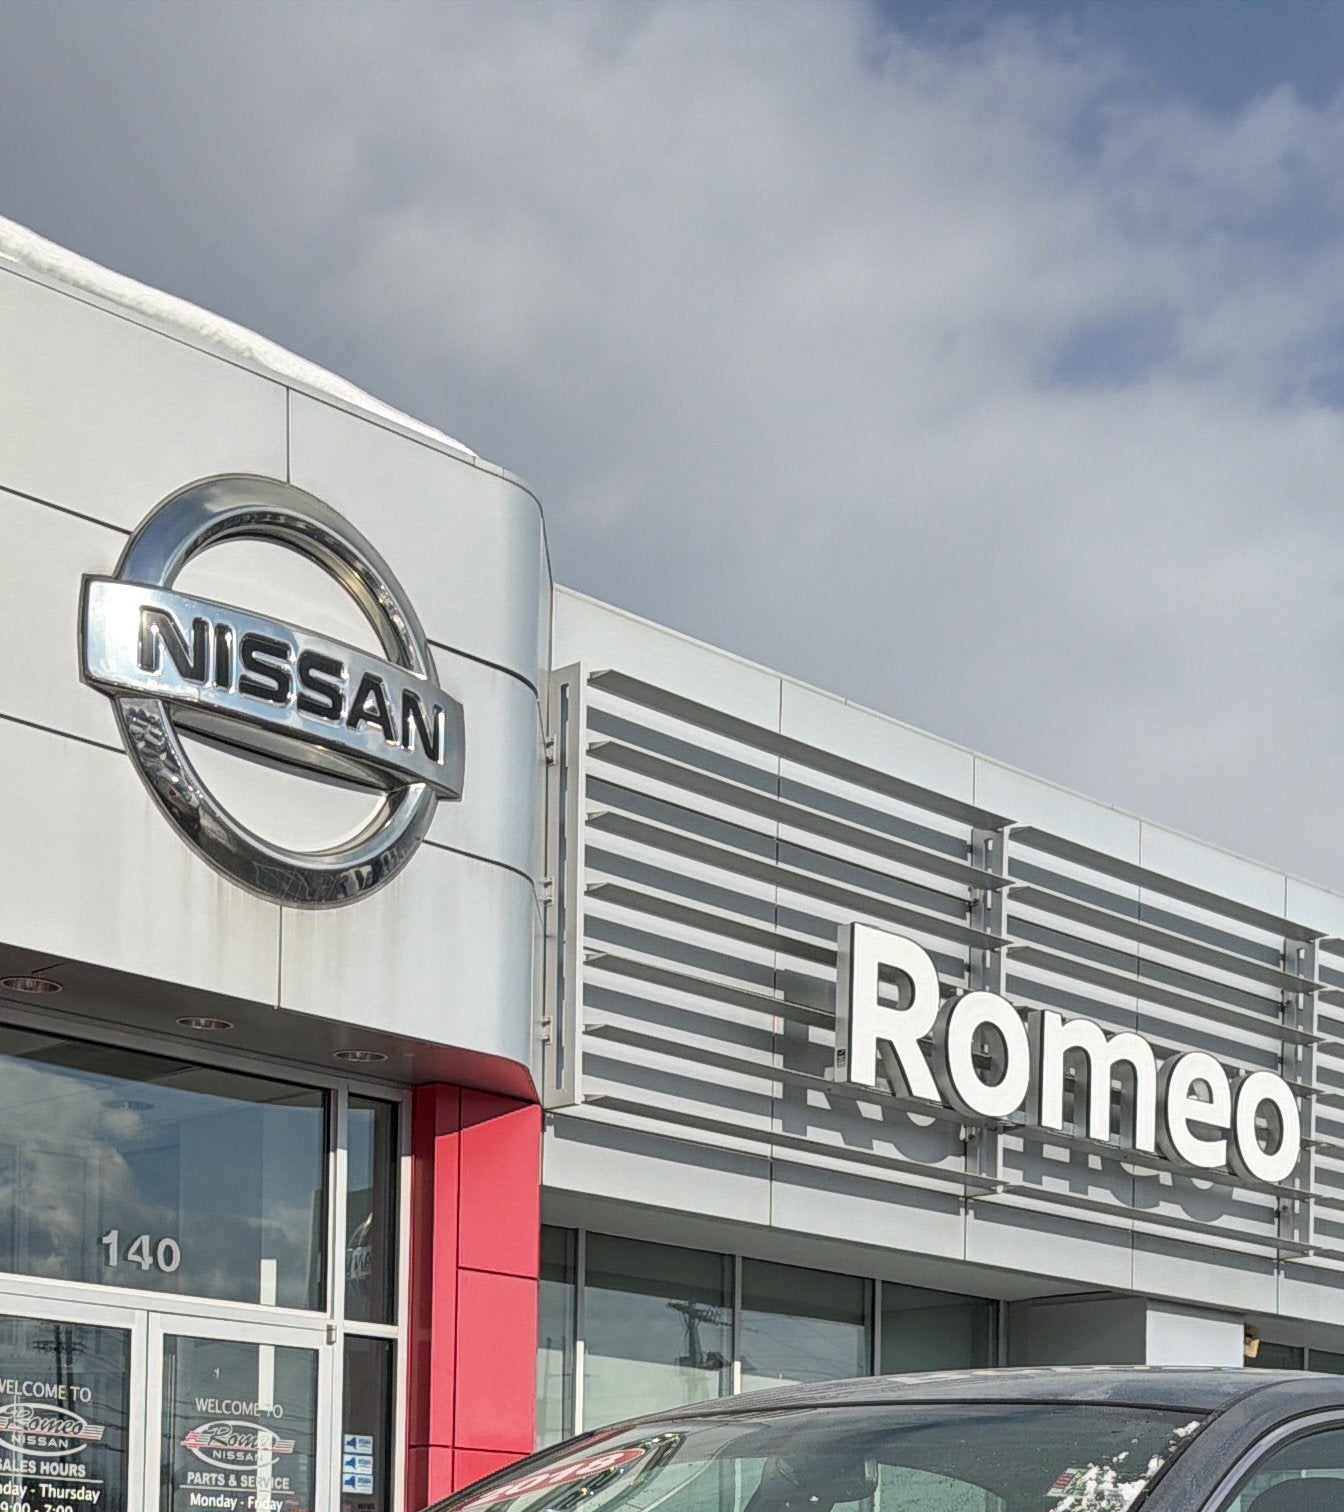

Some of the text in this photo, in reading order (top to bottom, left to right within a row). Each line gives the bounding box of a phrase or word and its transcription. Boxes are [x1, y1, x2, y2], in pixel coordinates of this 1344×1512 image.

[137, 605, 446, 765] NISSAN
[837, 921, 1301, 1183] Romeo
[101, 1229, 181, 1273] 140
[70, 1386, 92, 1403] TO
[195, 1397, 261, 1417] WELCOME
[0, 1406, 84, 1435] Romeo
[11, 1434, 69, 1449] NISSAN
[212, 1450, 263, 1462] NISSAN
[40, 1461, 86, 1477] HOURS
[187, 1472, 290, 1490] PARTS & SERVICE
[39, 1483, 101, 1505] Thursday
[189, 1492, 238, 1511] Monday
